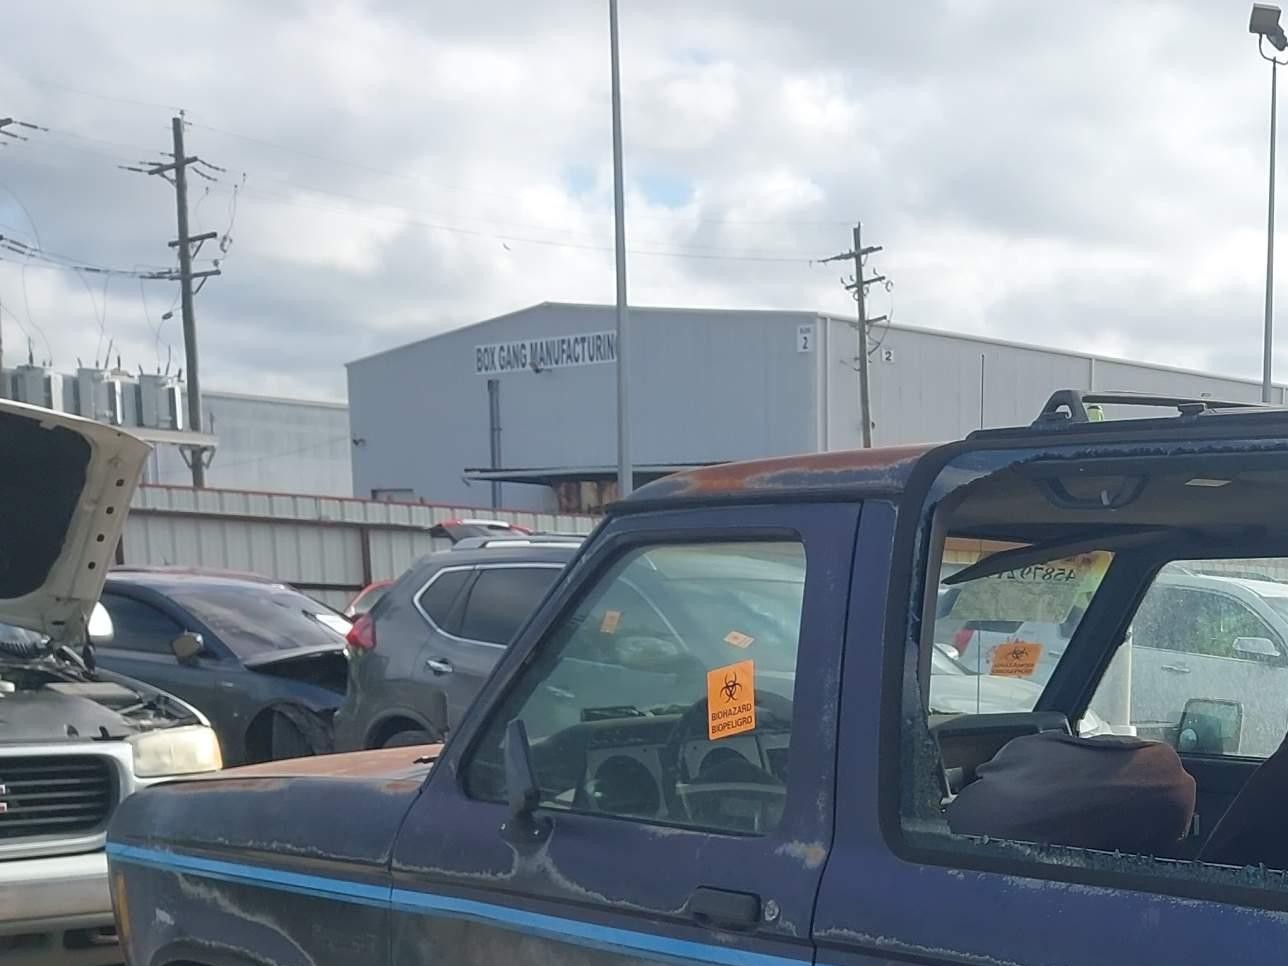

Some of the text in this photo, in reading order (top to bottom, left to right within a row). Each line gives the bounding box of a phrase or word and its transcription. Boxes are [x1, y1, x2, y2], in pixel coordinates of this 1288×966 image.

[476, 333, 617, 372] BOX GANG MANUFACTURIN
[885, 351, 892, 361] 2
[711, 703, 752, 721] BIOHAZARD
[711, 715, 753, 734] BIOPELIGRO
